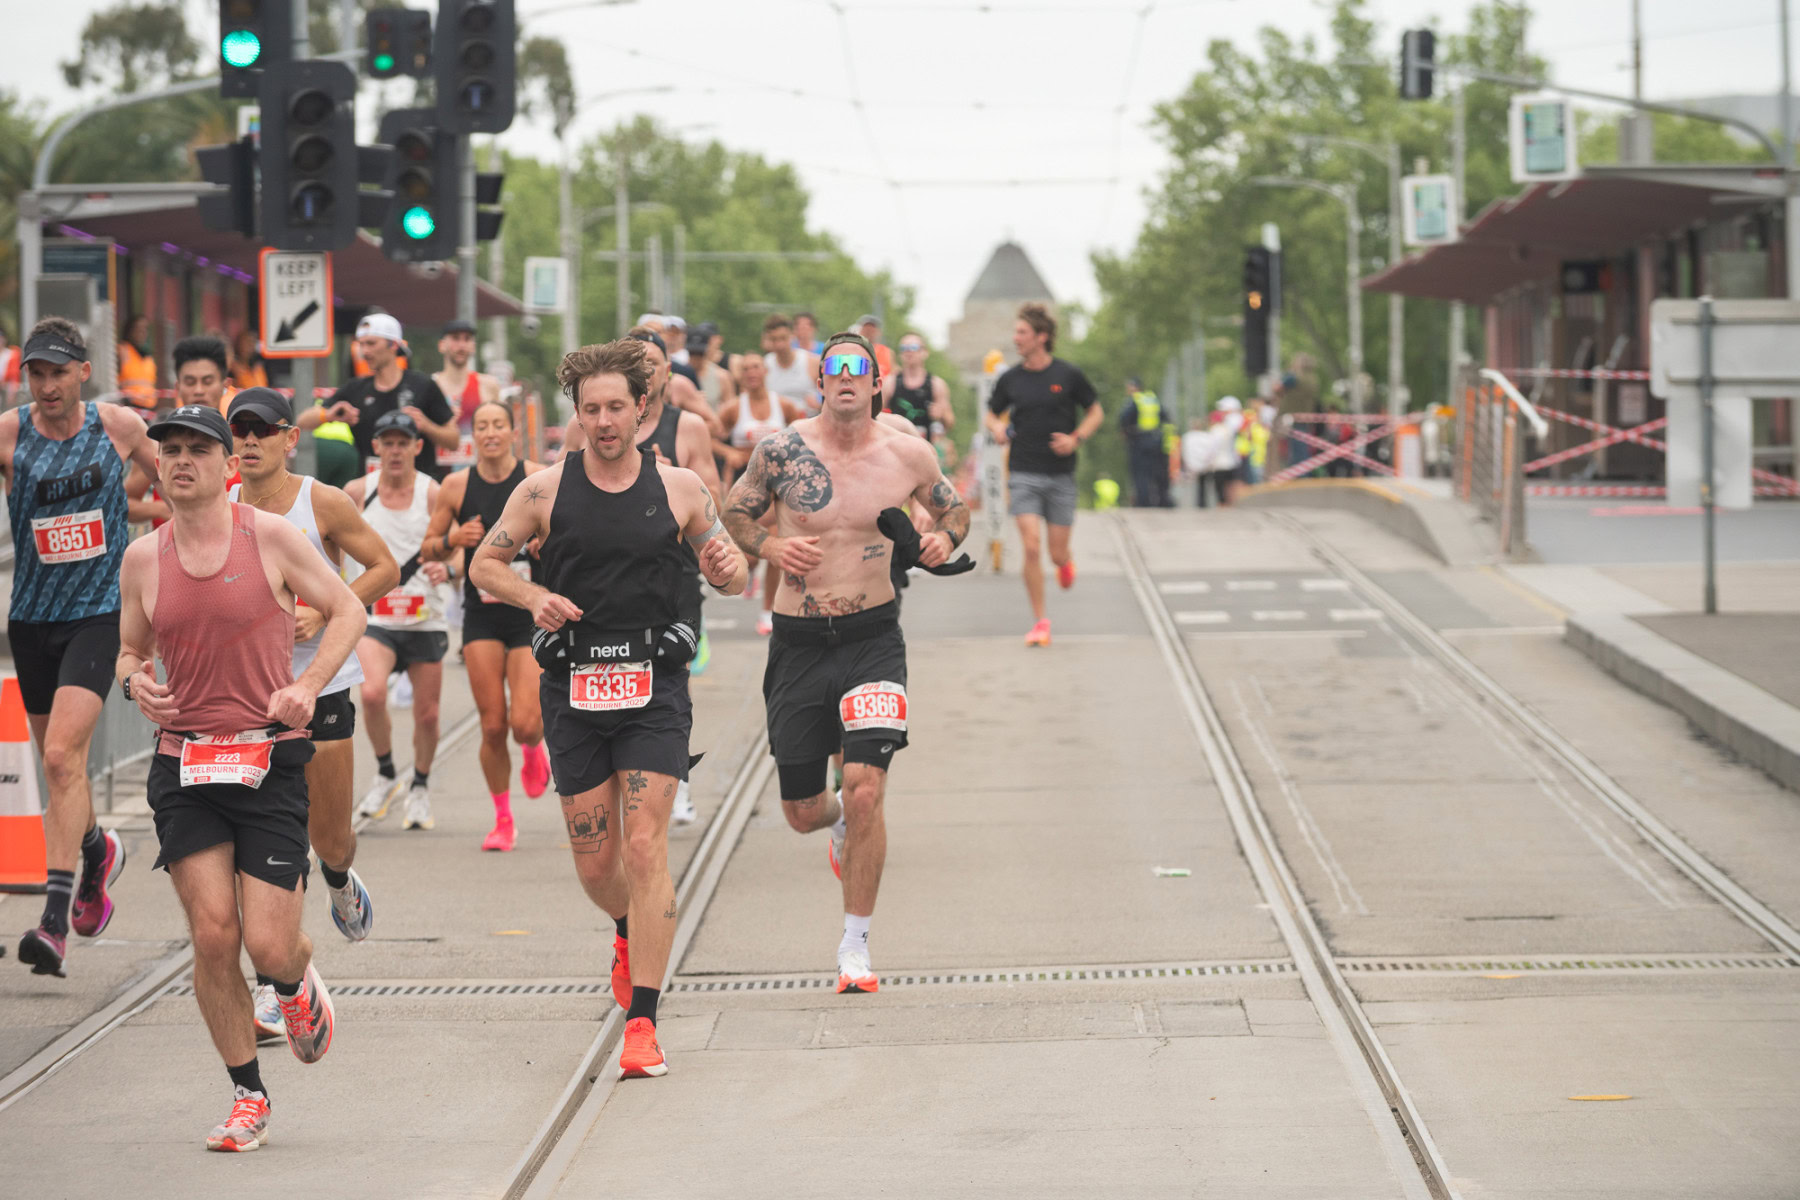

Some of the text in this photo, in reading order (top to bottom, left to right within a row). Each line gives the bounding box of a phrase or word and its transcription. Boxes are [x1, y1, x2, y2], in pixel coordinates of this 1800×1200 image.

[277, 260, 318, 277] KEEP
[278, 280, 315, 297] LEFT
[47, 524, 93, 553] 8551
[45, 551, 83, 561] MELBOURNE
[590, 642, 630, 658] nerd
[586, 674, 638, 700] 6335
[625, 698, 645, 706] 2025
[853, 693, 899, 718] 9366
[214, 752, 241, 763] 2223
[189, 766, 262, 778] MELBOURNE 2025
